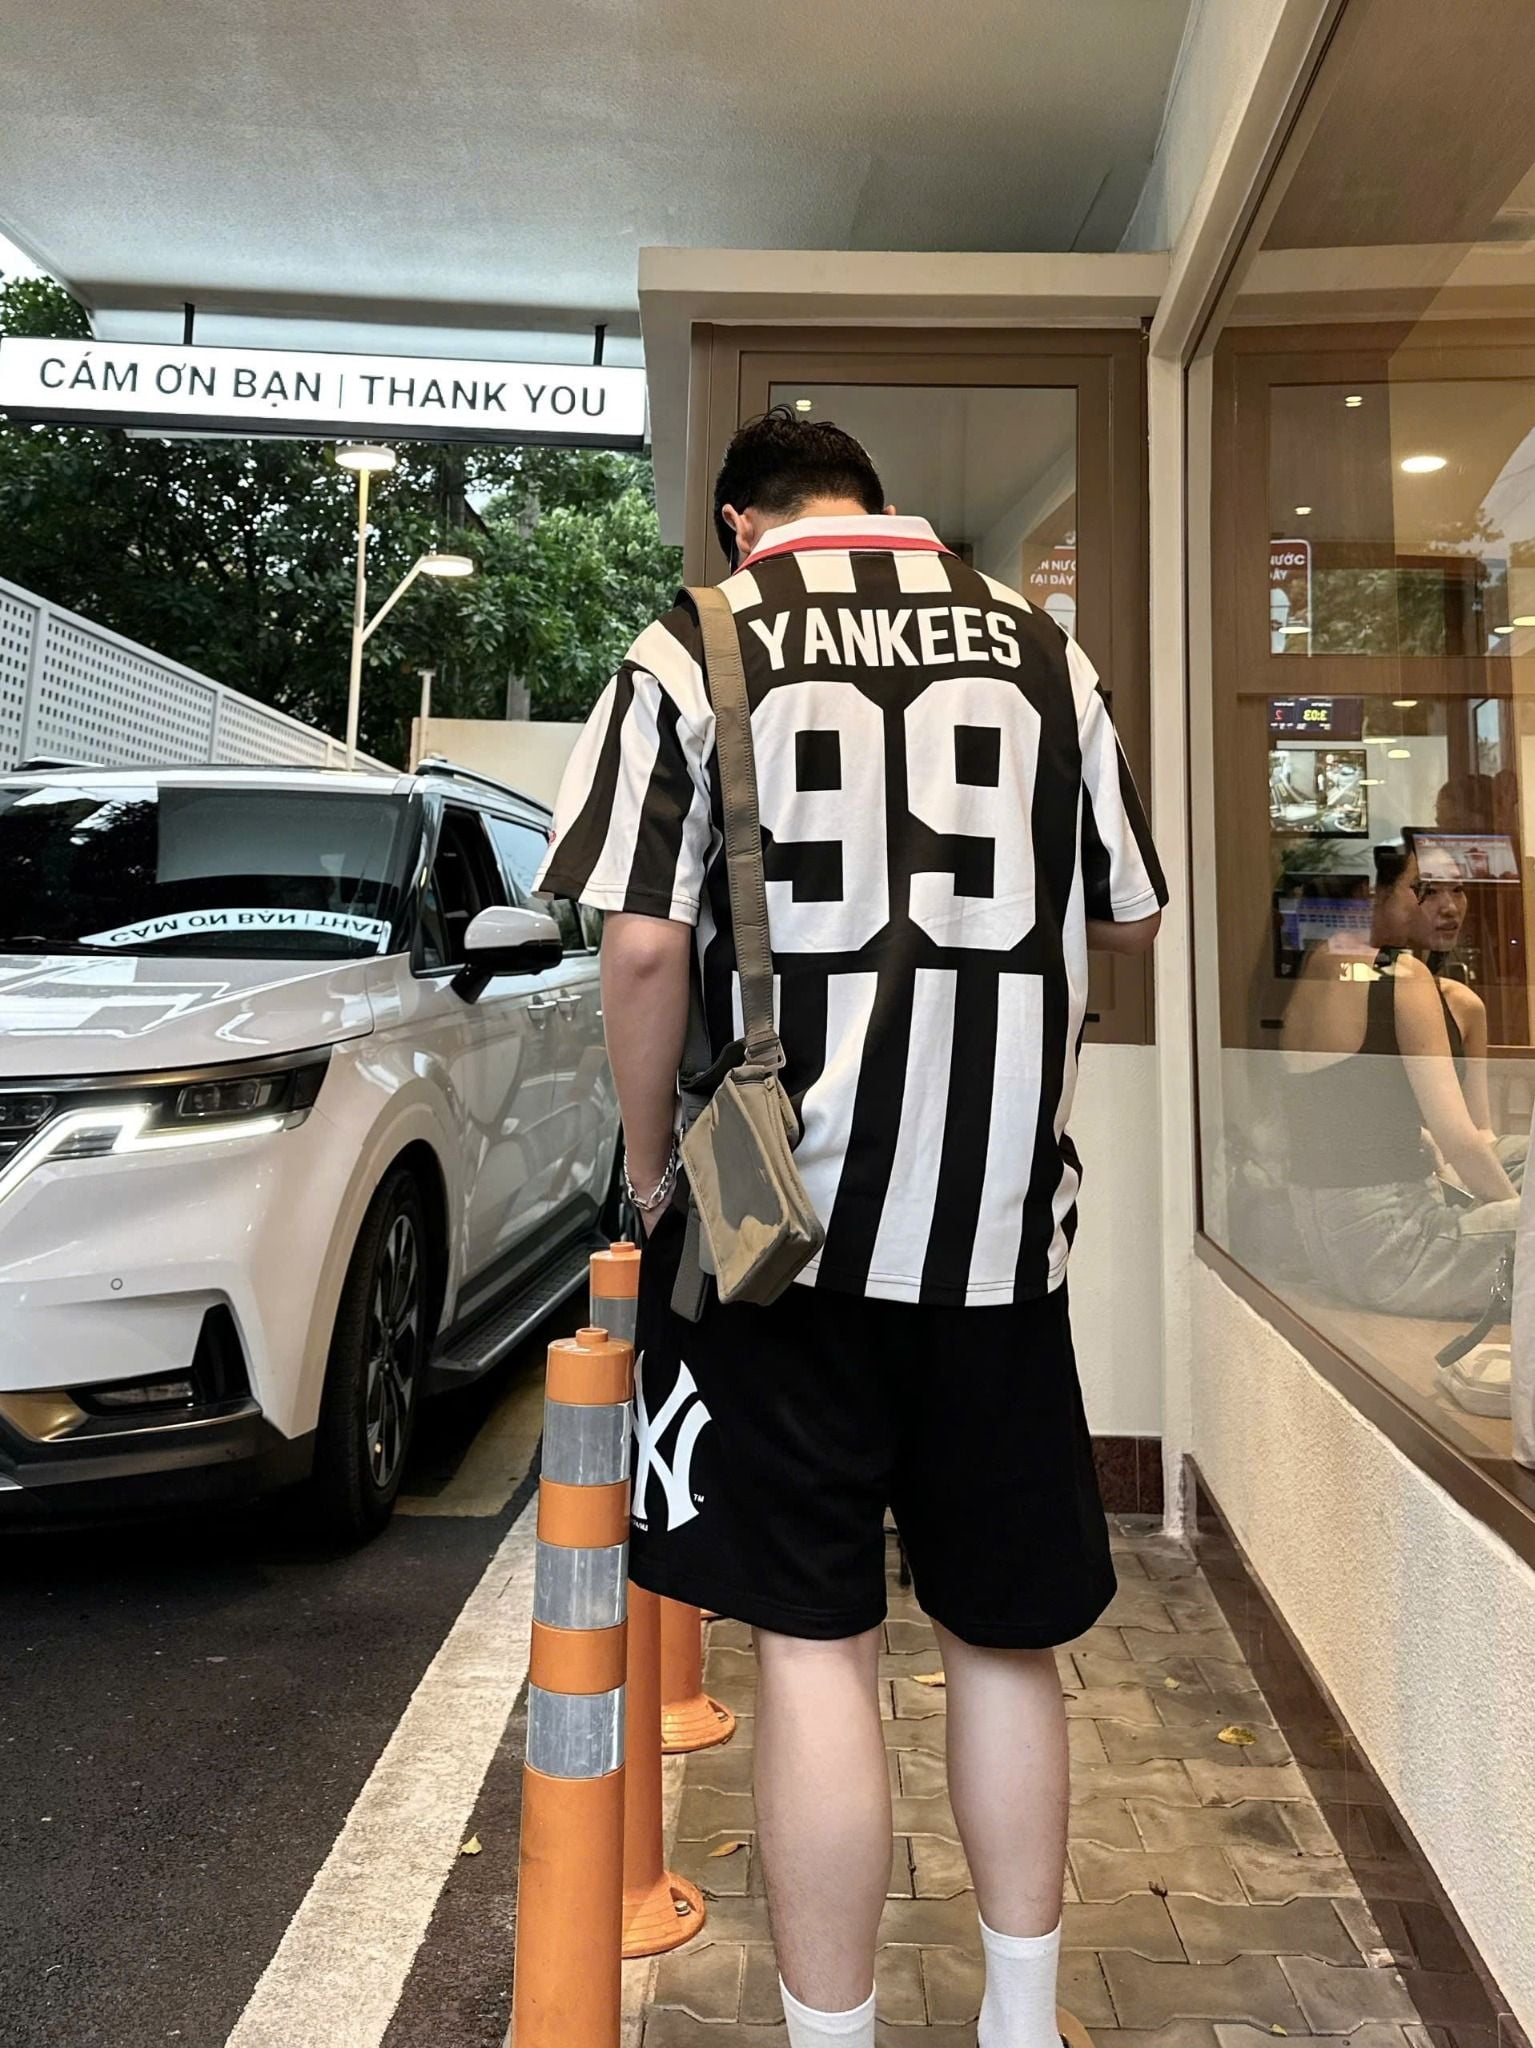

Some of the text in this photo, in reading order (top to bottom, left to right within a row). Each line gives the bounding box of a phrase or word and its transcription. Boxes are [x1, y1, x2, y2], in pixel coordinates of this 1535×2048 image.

[39, 351, 606, 417] CÁM ƠN BẠN THANK YOU
[748, 606, 1021, 671] YANKEES
[750, 677, 1041, 953] 99
